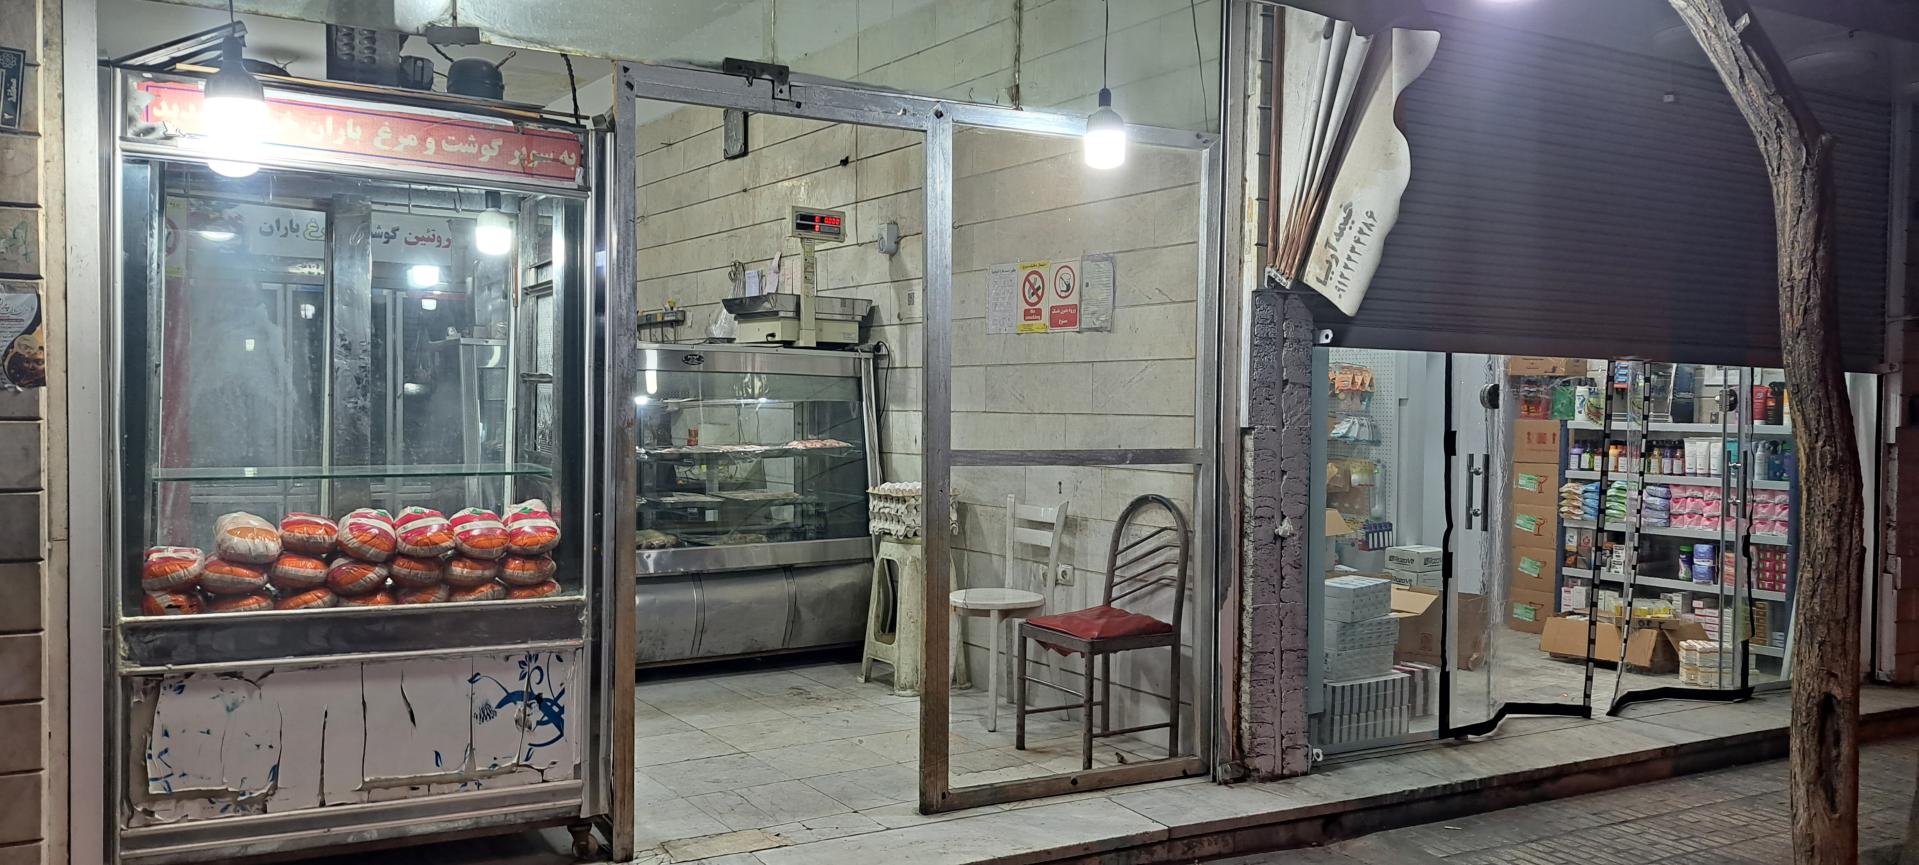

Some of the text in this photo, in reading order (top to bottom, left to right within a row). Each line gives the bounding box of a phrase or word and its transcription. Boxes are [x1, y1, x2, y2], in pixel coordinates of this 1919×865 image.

[309, 116, 362, 145] باران
[373, 121, 417, 152] مرغ
[424, 135, 436, 155] و
[441, 134, 503, 162] گوشت
[558, 149, 577, 171] به
[258, 216, 452, 248] روتئین گوش رغ باران
[1316, 202, 1354, 286] خیمه آریا
